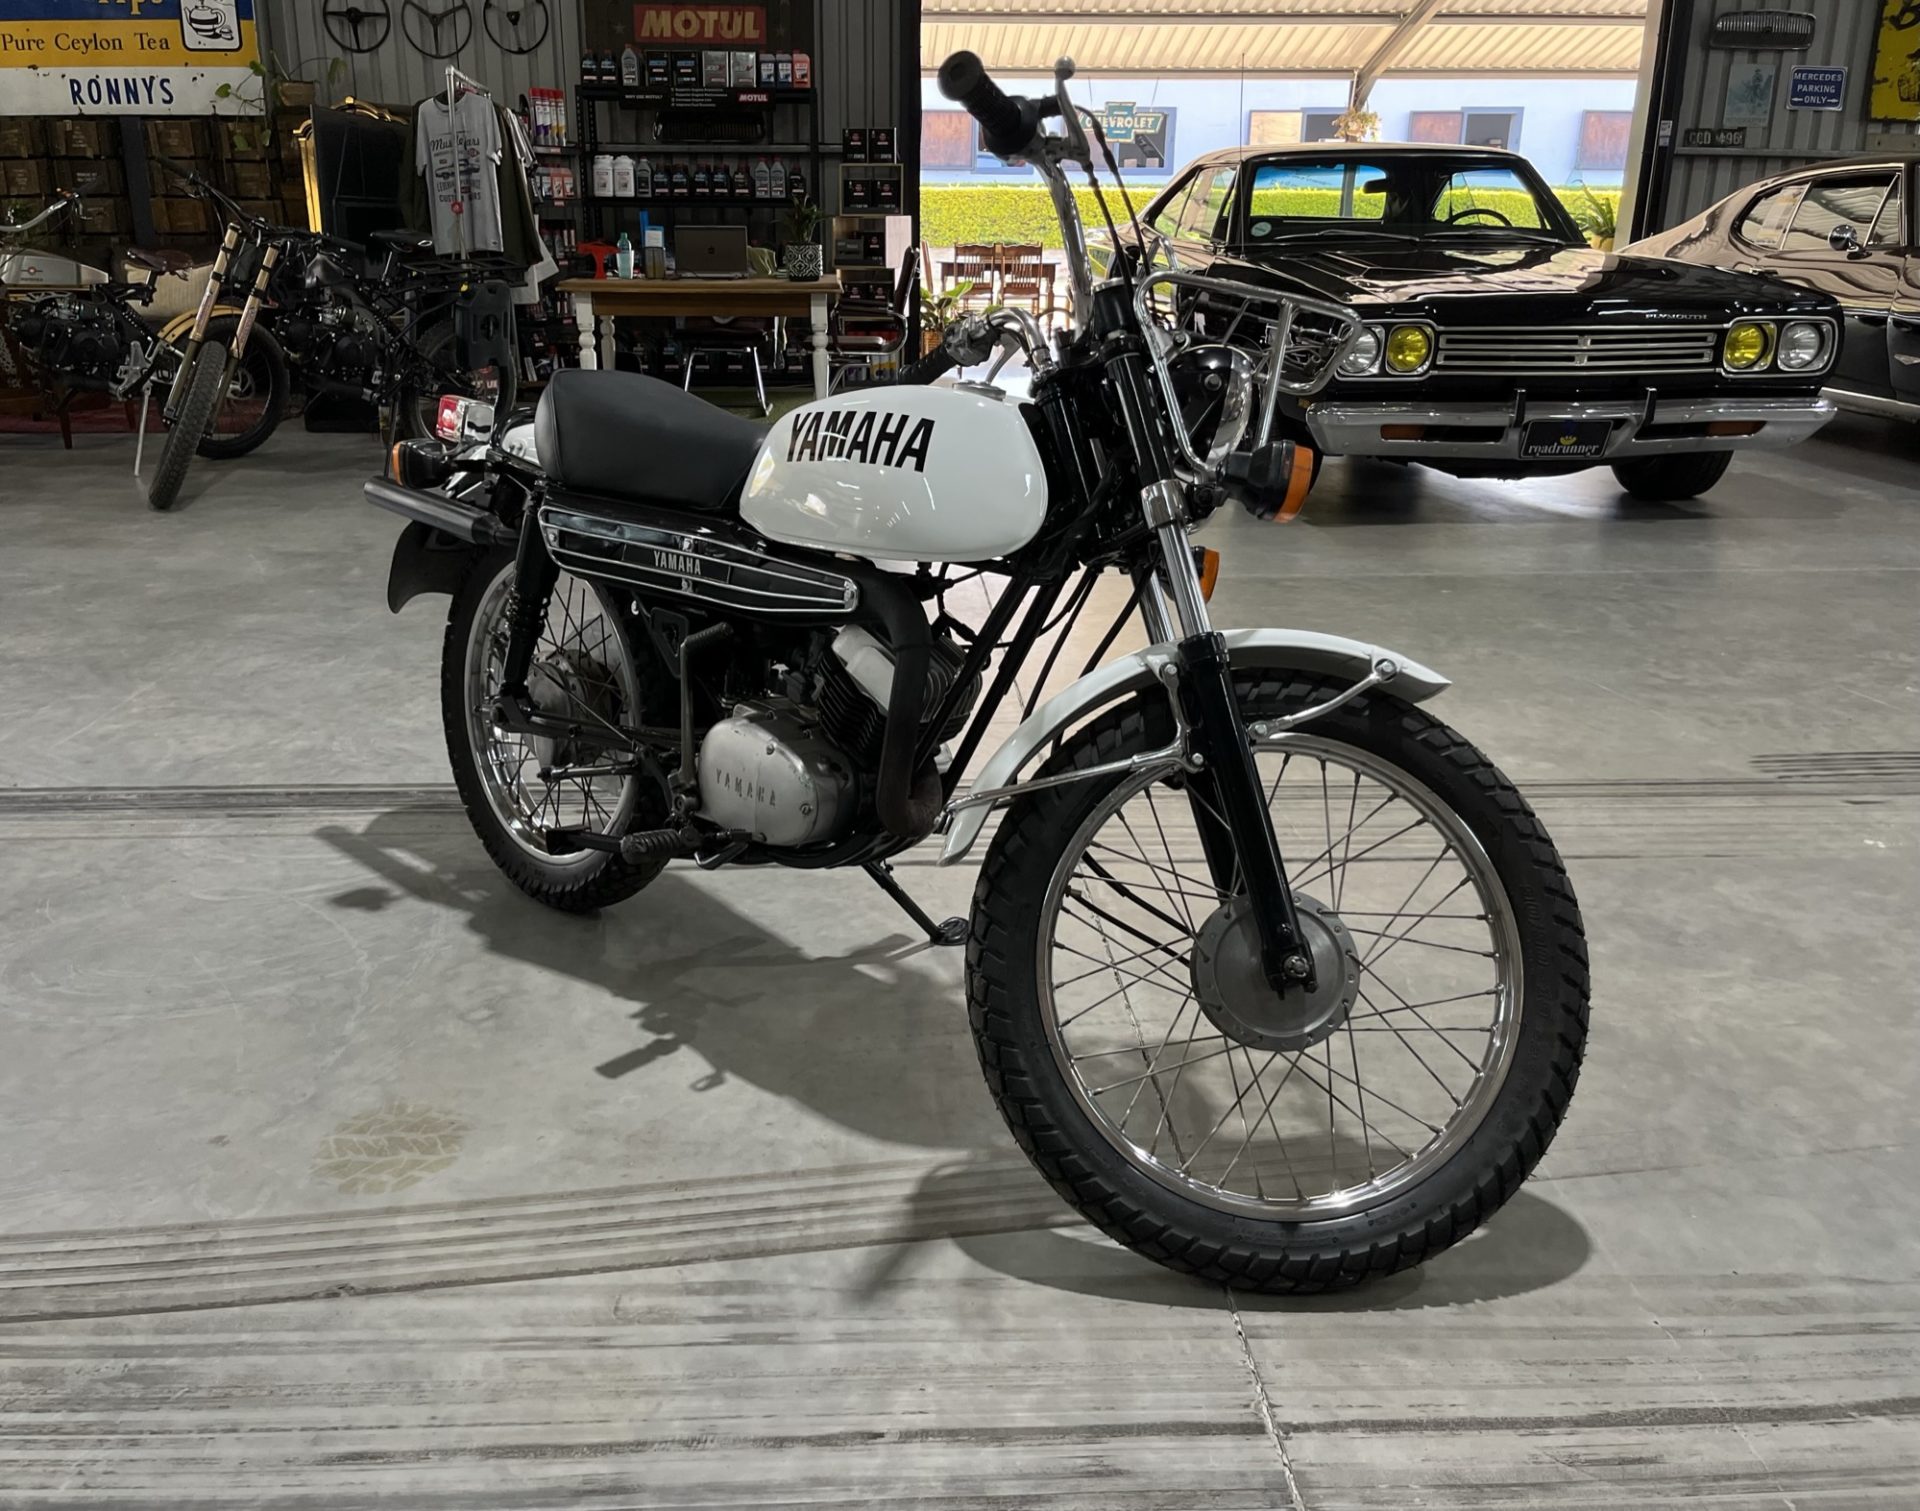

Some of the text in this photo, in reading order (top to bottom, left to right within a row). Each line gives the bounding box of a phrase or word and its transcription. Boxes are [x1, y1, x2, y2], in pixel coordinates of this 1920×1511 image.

[640, 10, 762, 39] MOTUL
[1, 32, 170, 55] Pure Ceylon Tea
[1794, 72, 1842, 82] MERCEDES
[69, 78, 174, 105] RONNYS
[1797, 84, 1836, 93] PARKING
[739, 94, 769, 102] MOTUL
[1804, 95, 1827, 104] ONLY
[1085, 116, 1155, 129] CEVROLET
[430, 135, 464, 151] Musle
[786, 410, 936, 473] YAMAHA
[1528, 442, 1599, 455] roadrunner
[653, 550, 701, 576] YAMAHA
[716, 768, 776, 808] YAMAHA
